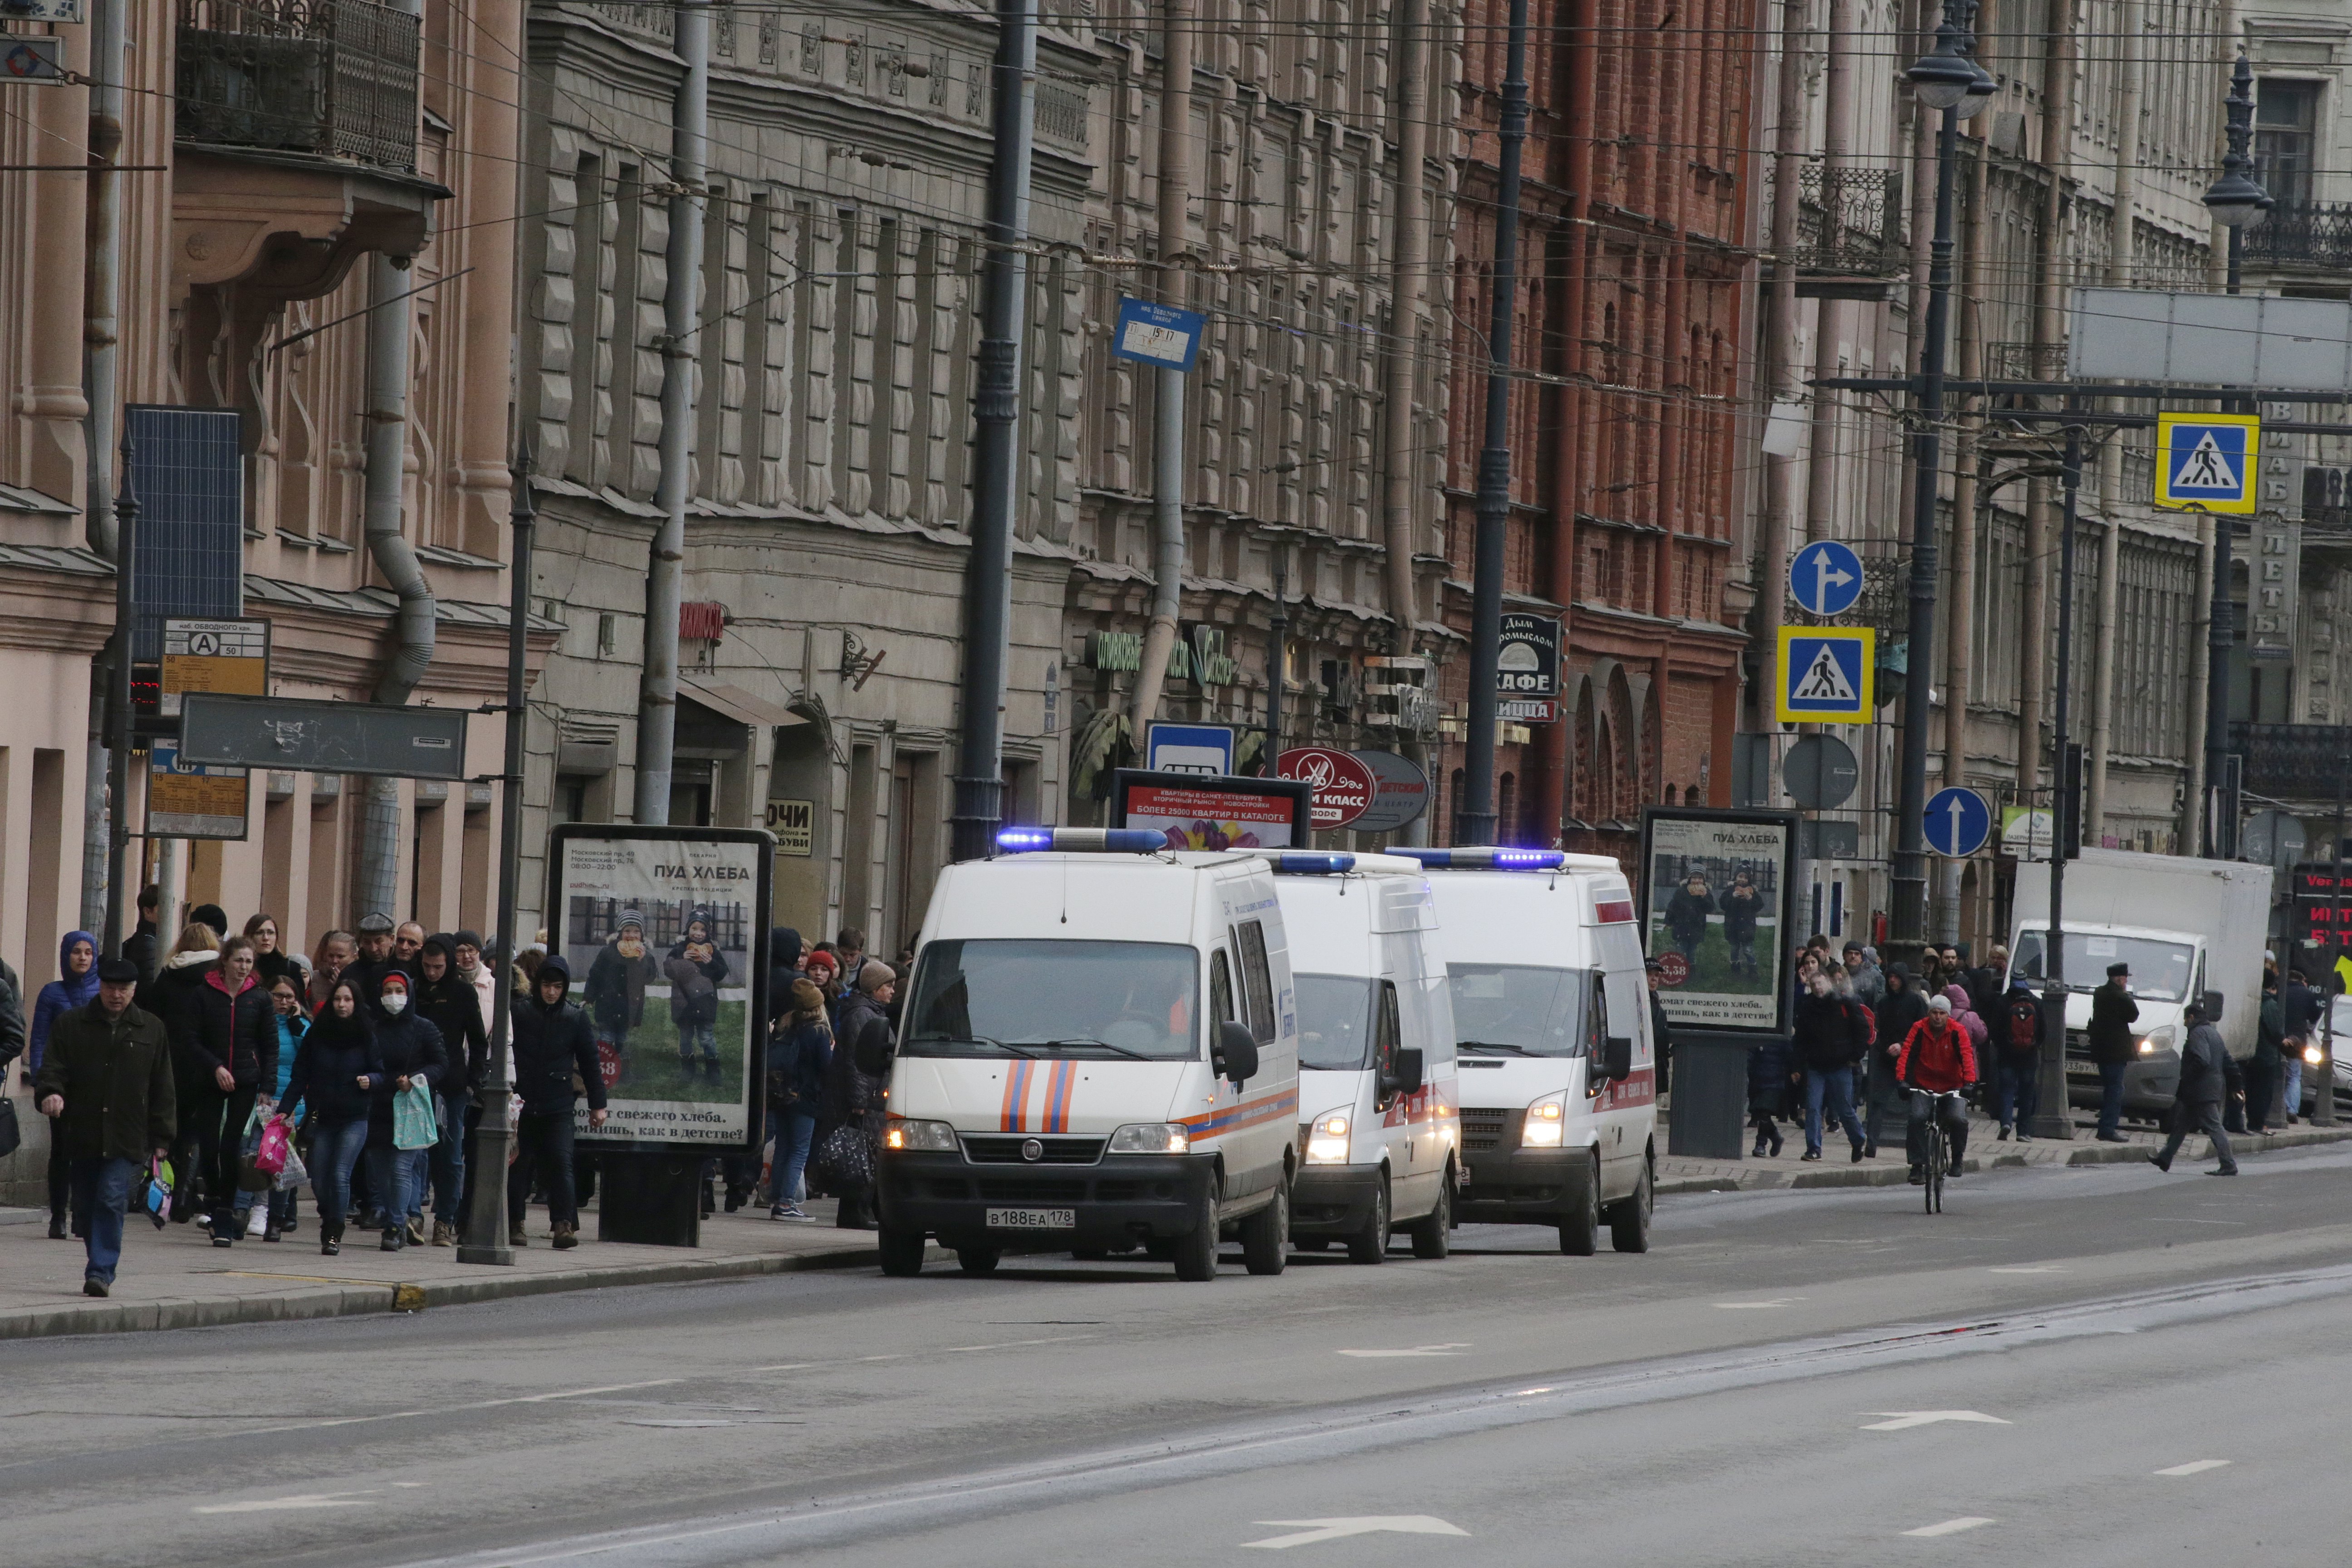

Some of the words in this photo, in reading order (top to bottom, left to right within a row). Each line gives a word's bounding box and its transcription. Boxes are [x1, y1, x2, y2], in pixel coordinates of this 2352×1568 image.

[1152, 327, 1161, 338] 15
[1166, 330, 1174, 341] 17
[2254, 401, 2292, 634] ВИАБИЛЕТЫ
[1505, 617, 1533, 630] Дым
[196, 635, 212, 652] А
[1499, 632, 1553, 649] ромыслом
[1496, 703, 1549, 718] ИЦЦА
[1379, 782, 1425, 793] ДЕТСКИЙ
[1153, 796, 1192, 804] ВТОРИЧНЫЙ
[1201, 793, 1263, 802] САНКТ-ПЕТЕРБУРГЕ
[1323, 795, 1364, 807] КЛАСС
[1137, 805, 1166, 813] БОЛЕЕ
[1168, 808, 1190, 816] 25000
[1193, 809, 1231, 818] КВАРТИР
[1241, 812, 1285, 821] КАТАЛОГЕ
[778, 838, 808, 848] БУВИ
[1713, 833, 1735, 843] ПУД
[1740, 835, 1779, 844] ХЛЕБА
[654, 865, 686, 879] ПУД
[692, 866, 750, 880] ХЛЕБА
[1687, 999, 1728, 1007] свежего
[1731, 1012, 1774, 1020] детстве?
[617, 1110, 676, 1121] свежего
[681, 1112, 726, 1123] хлеба.
[638, 1126, 666, 1136] как
[670, 1128, 678, 1137] в
[681, 1128, 743, 1140] детстве?
[1027, 1146, 1038, 1155] FIAT
[1050, 1211, 1071, 1222] 178
